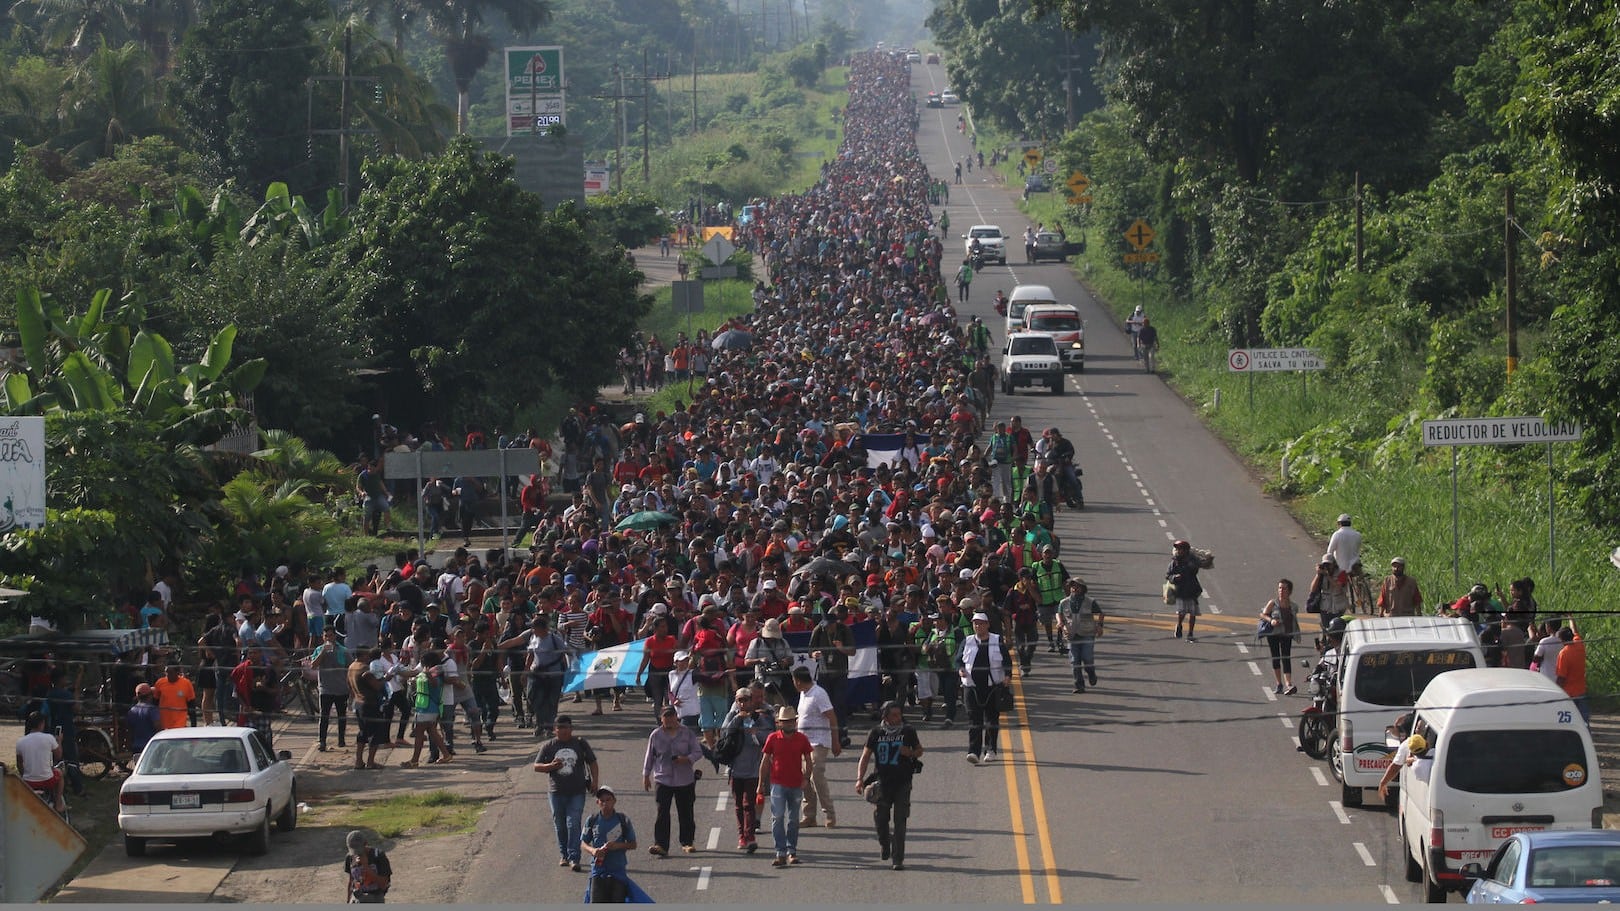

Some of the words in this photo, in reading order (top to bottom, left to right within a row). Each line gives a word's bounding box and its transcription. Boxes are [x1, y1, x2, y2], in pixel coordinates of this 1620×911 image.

[514, 75, 556, 85] PEMEX
[1280, 351, 1288, 359] EL
[1258, 360, 1281, 368] SALVA
[1288, 360, 1297, 368] TU
[1303, 360, 1320, 368] VIDA
[1429, 423, 1487, 440] REDUCTOR
[1492, 423, 1506, 438] DE
[1557, 710, 1572, 724] 25
